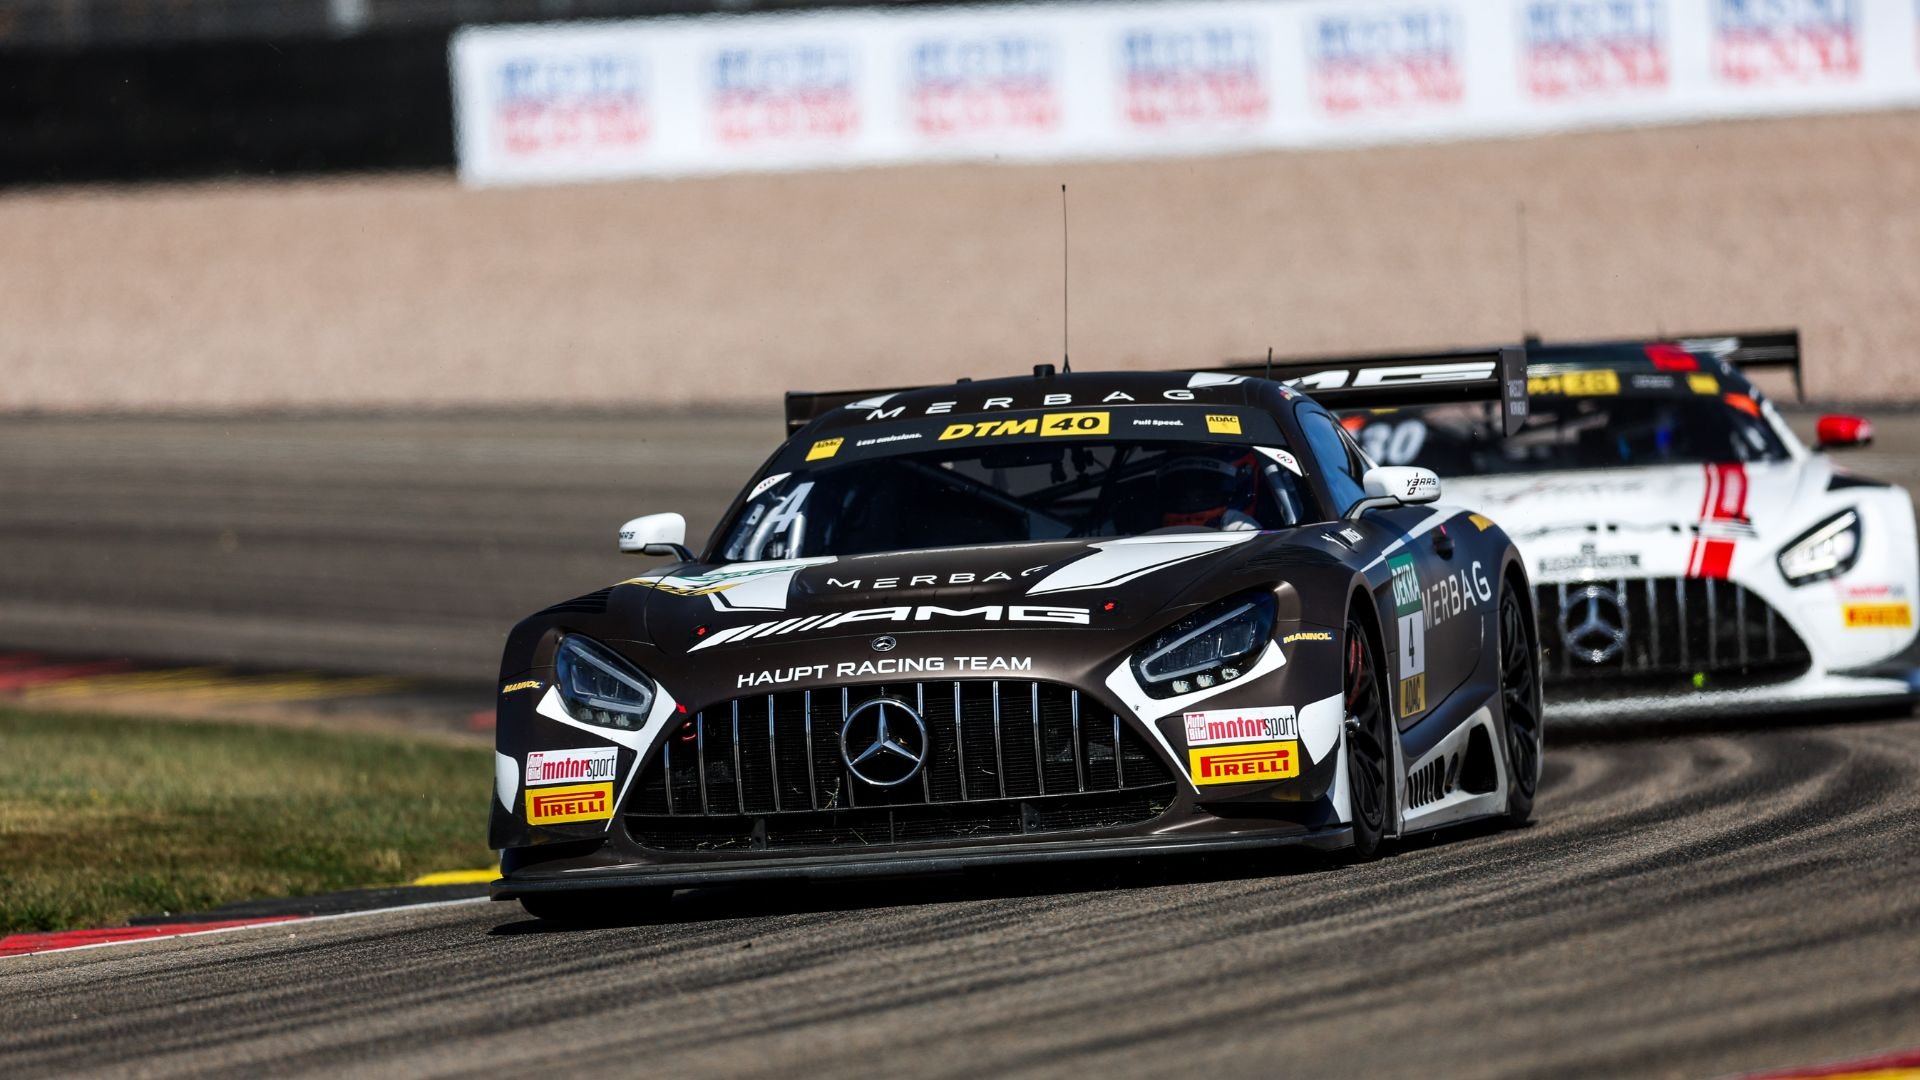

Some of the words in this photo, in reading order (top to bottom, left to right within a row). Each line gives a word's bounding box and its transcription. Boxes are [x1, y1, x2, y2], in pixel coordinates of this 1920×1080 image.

[865, 389, 1195, 421] MERBAG
[937, 418, 1039, 441] DTM
[1050, 416, 1100, 431] 40
[1208, 416, 1238, 424] ADAC
[1391, 561, 1422, 608] DEKRA
[1422, 560, 1492, 632] MERBAG
[817, 605, 1091, 630] AMG
[1283, 632, 1333, 644] MANNOL
[1408, 617, 1415, 669] 4
[736, 664, 829, 689] HAUPT
[836, 657, 945, 678] RACING
[953, 656, 1033, 672] TEAM
[1207, 714, 1297, 740] motorsport
[542, 754, 616, 780] motorsport
[1199, 749, 1290, 778] PIRELLI
[533, 790, 606, 818] PIRELLI
